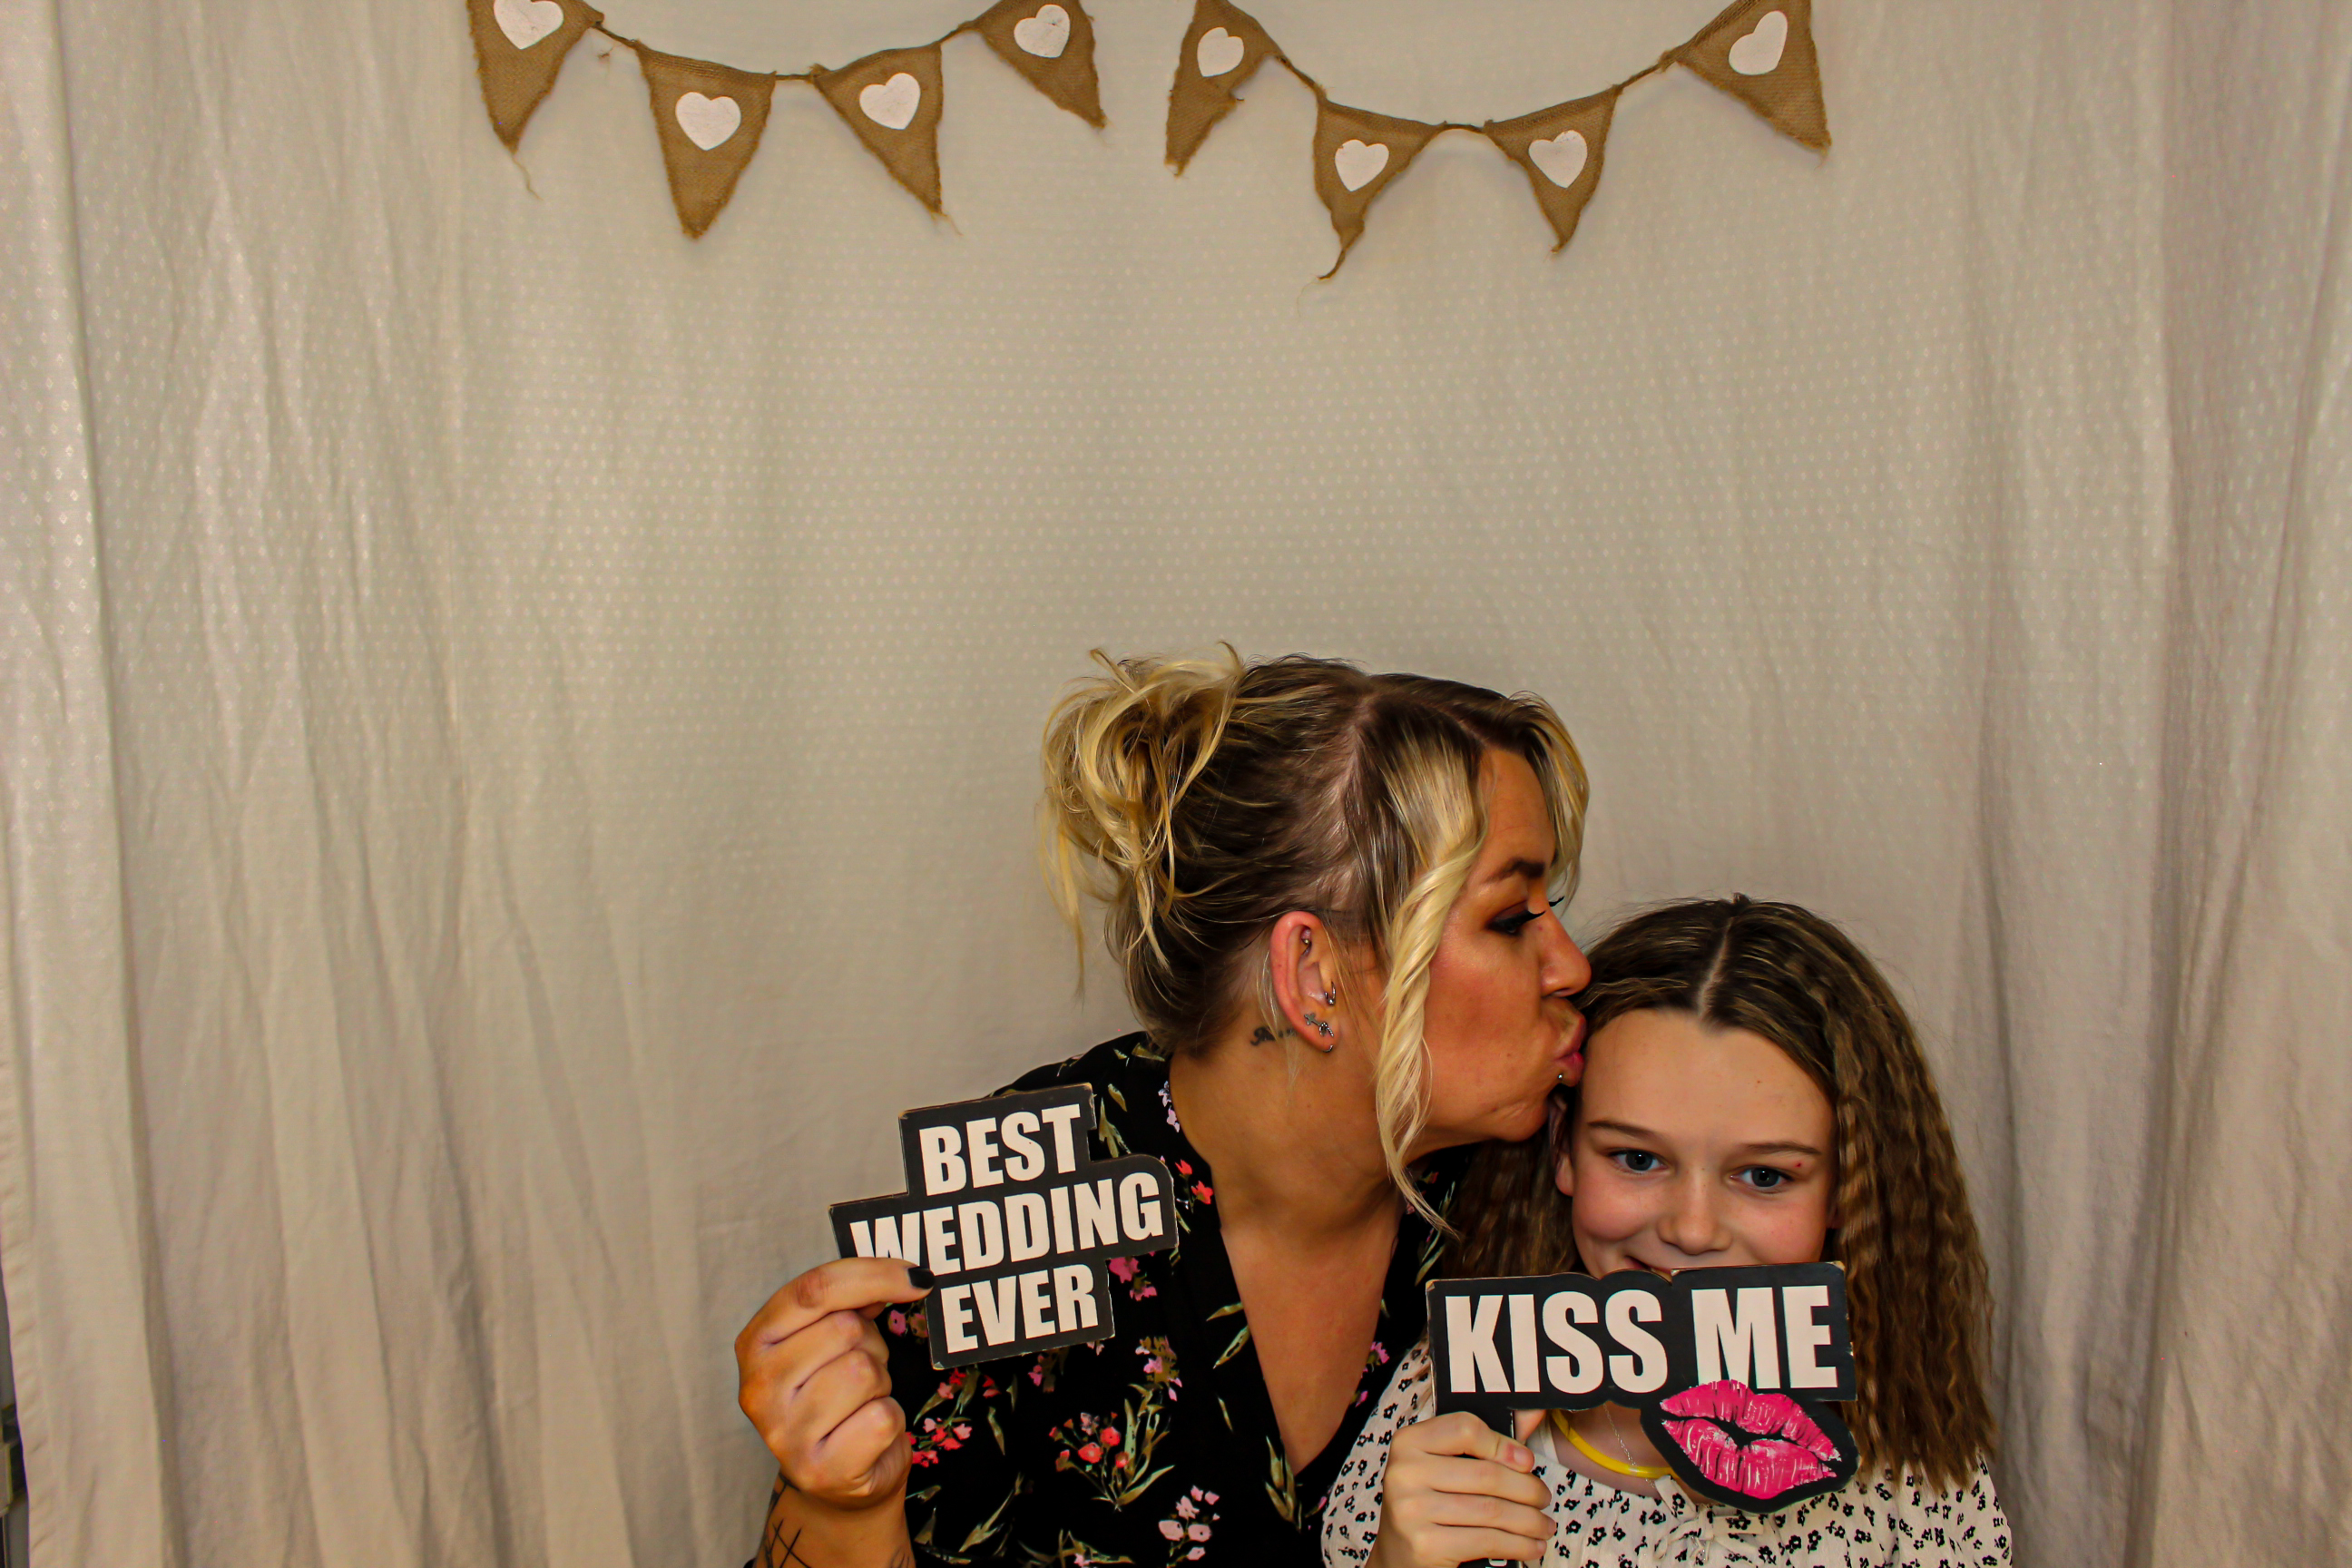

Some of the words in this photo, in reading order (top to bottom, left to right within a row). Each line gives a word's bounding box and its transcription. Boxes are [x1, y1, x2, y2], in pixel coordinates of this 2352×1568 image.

[918, 1103, 1081, 1196] BEST
[849, 1171, 1163, 1277] WEDDING
[940, 1264, 1099, 1354] EVER
[1445, 1289, 1669, 1394] KISS
[1690, 1285, 1838, 1389] ME
